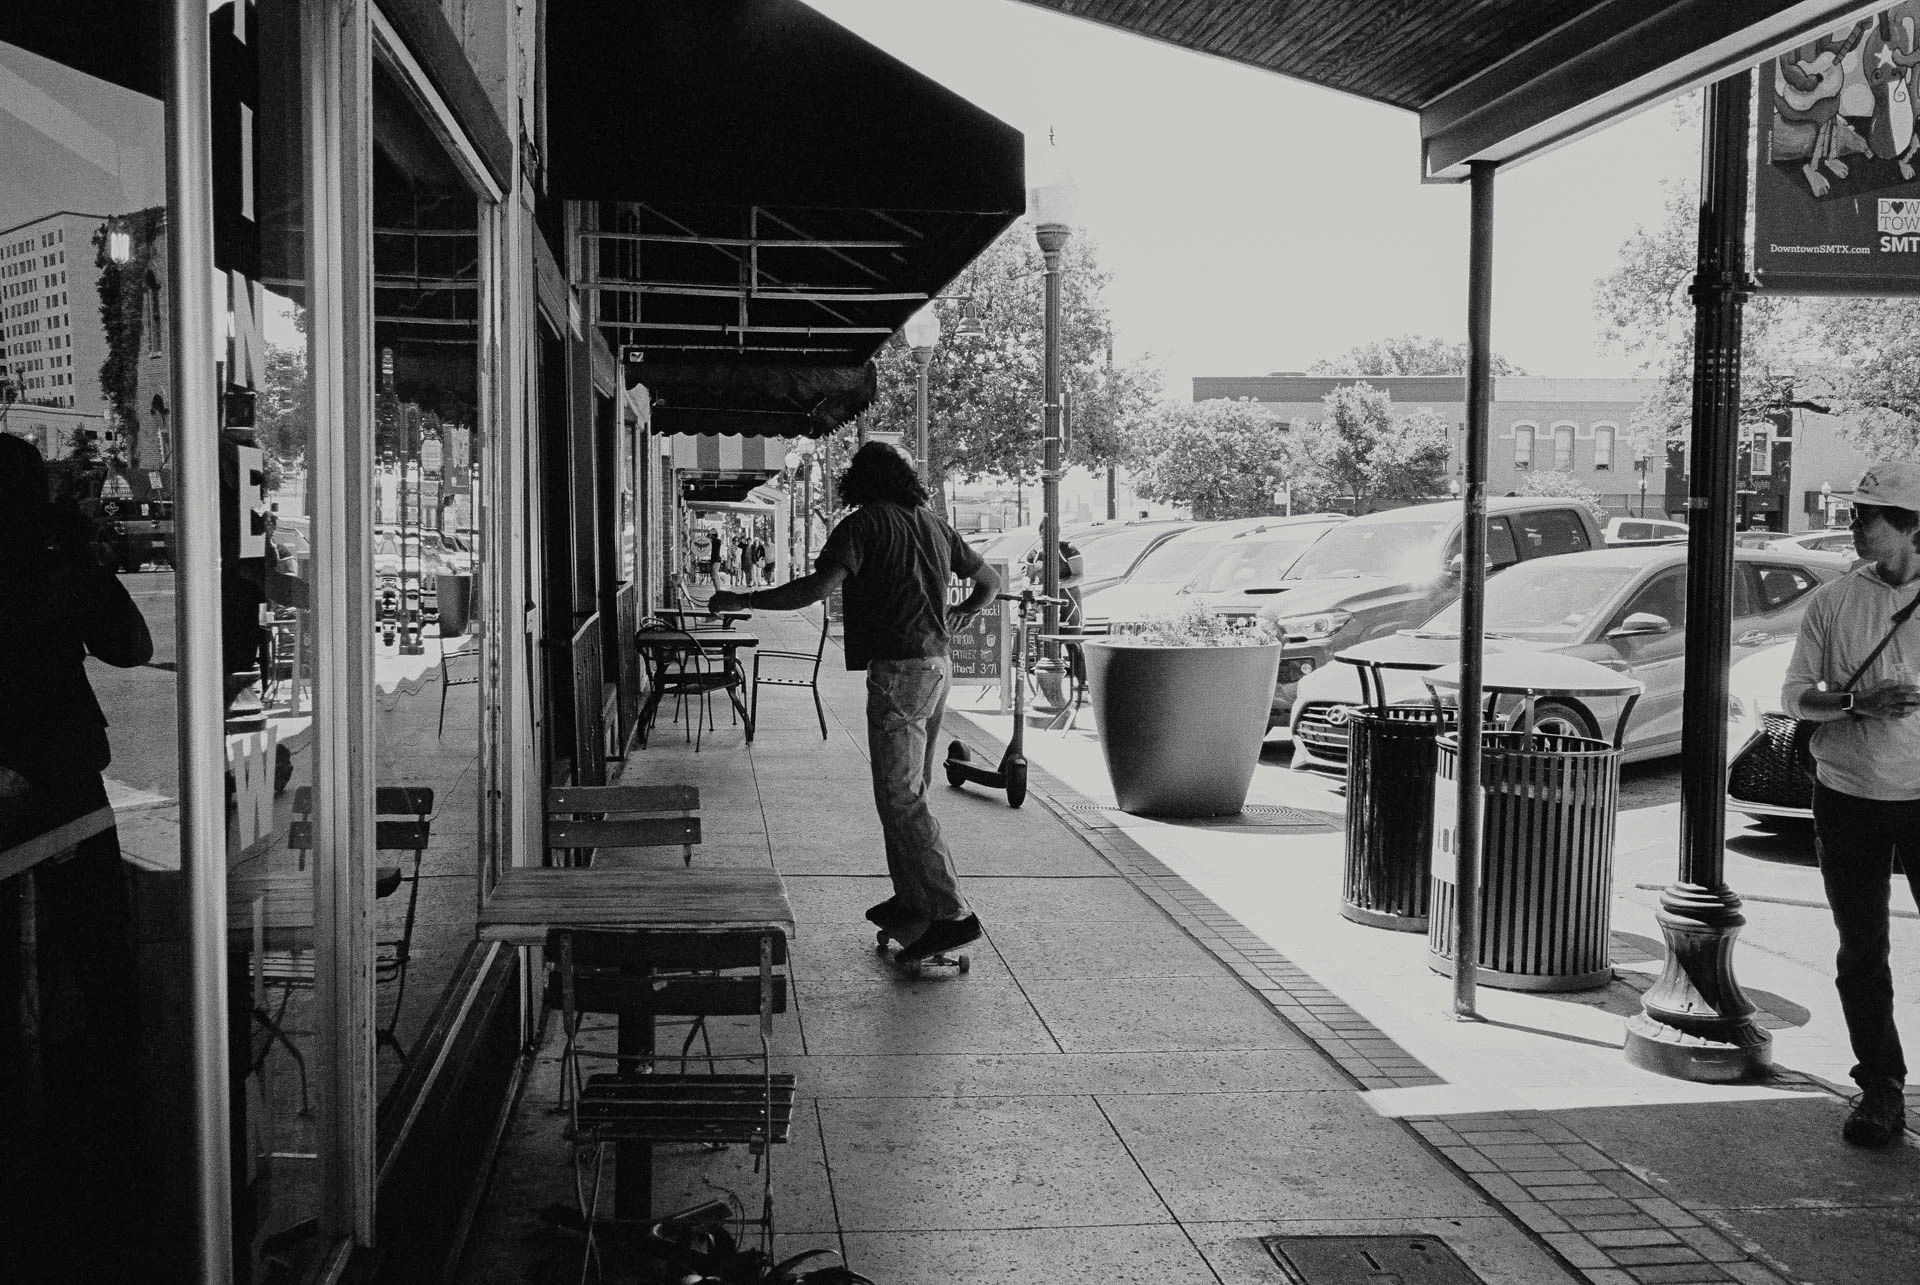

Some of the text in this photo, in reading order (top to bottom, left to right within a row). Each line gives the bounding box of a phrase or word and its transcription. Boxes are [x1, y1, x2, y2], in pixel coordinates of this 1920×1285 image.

[1880, 216, 1920, 231] TOW
[1770, 243, 1870, 254] DowntownSMTX.com
[1880, 236, 1920, 253] SMT
